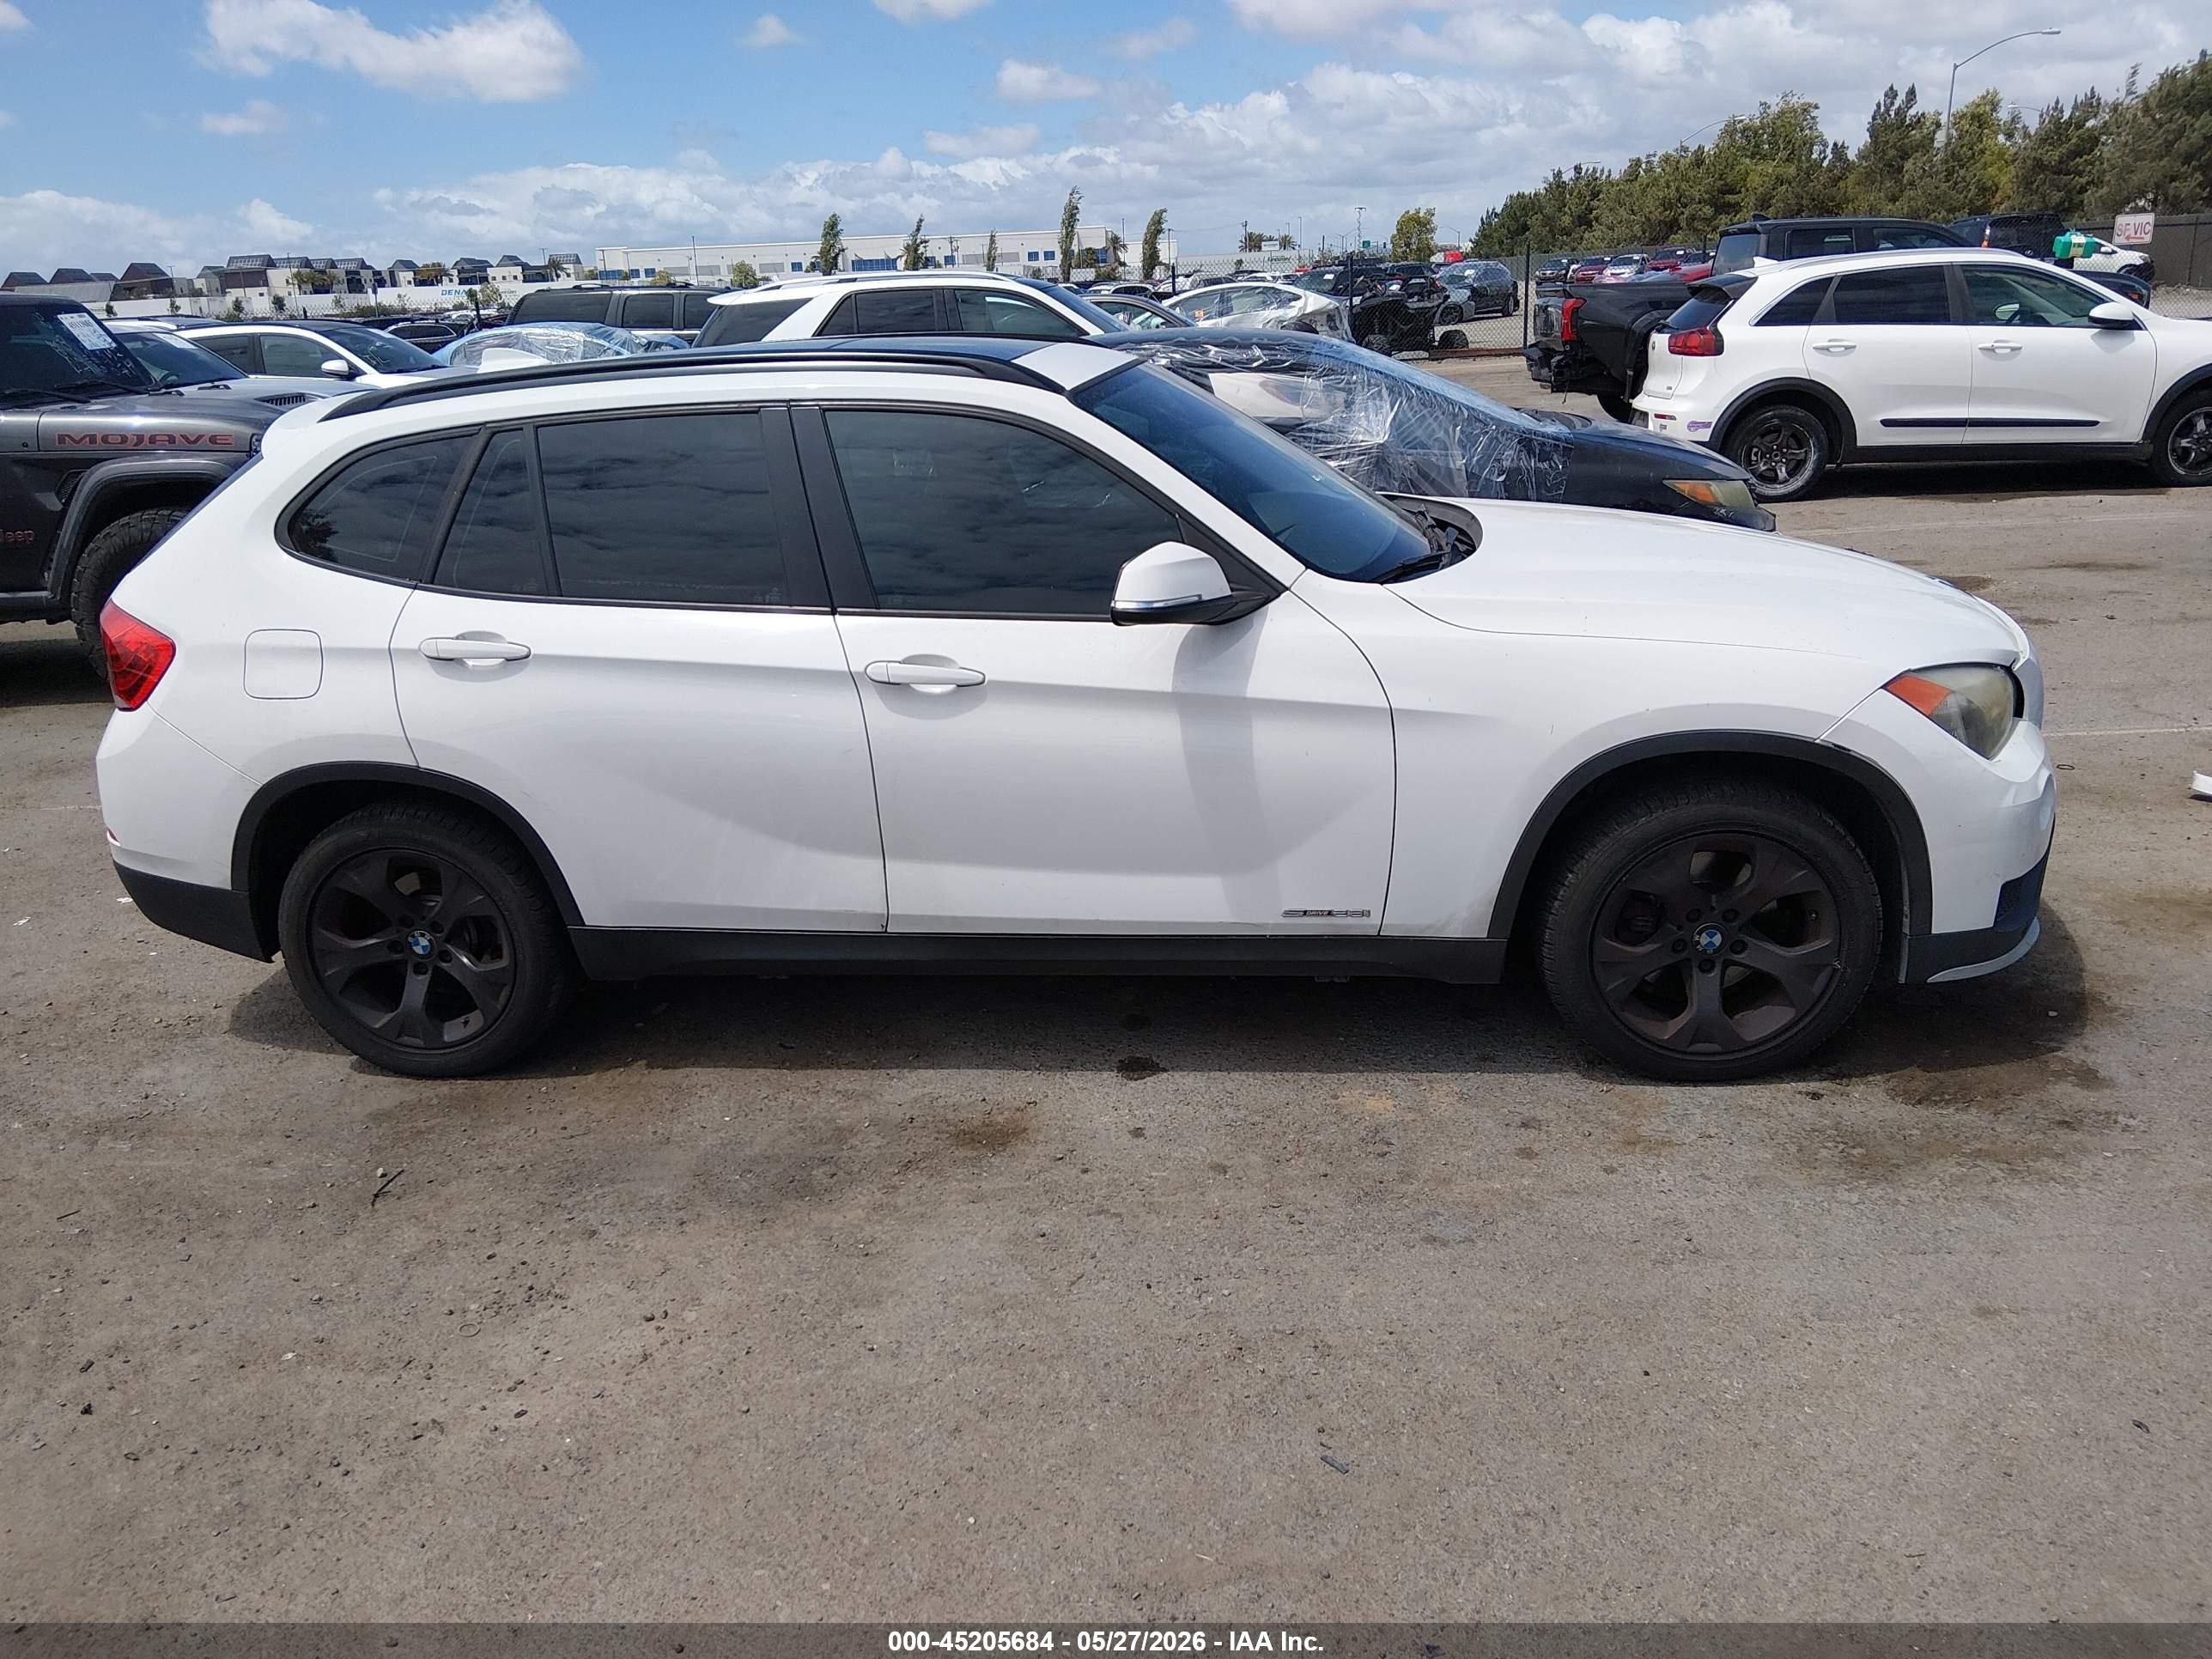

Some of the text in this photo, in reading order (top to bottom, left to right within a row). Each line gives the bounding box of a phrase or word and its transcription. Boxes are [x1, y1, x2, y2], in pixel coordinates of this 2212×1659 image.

[2117, 222, 2151, 237] SF VIC
[56, 432, 234, 447] MOJAVE
